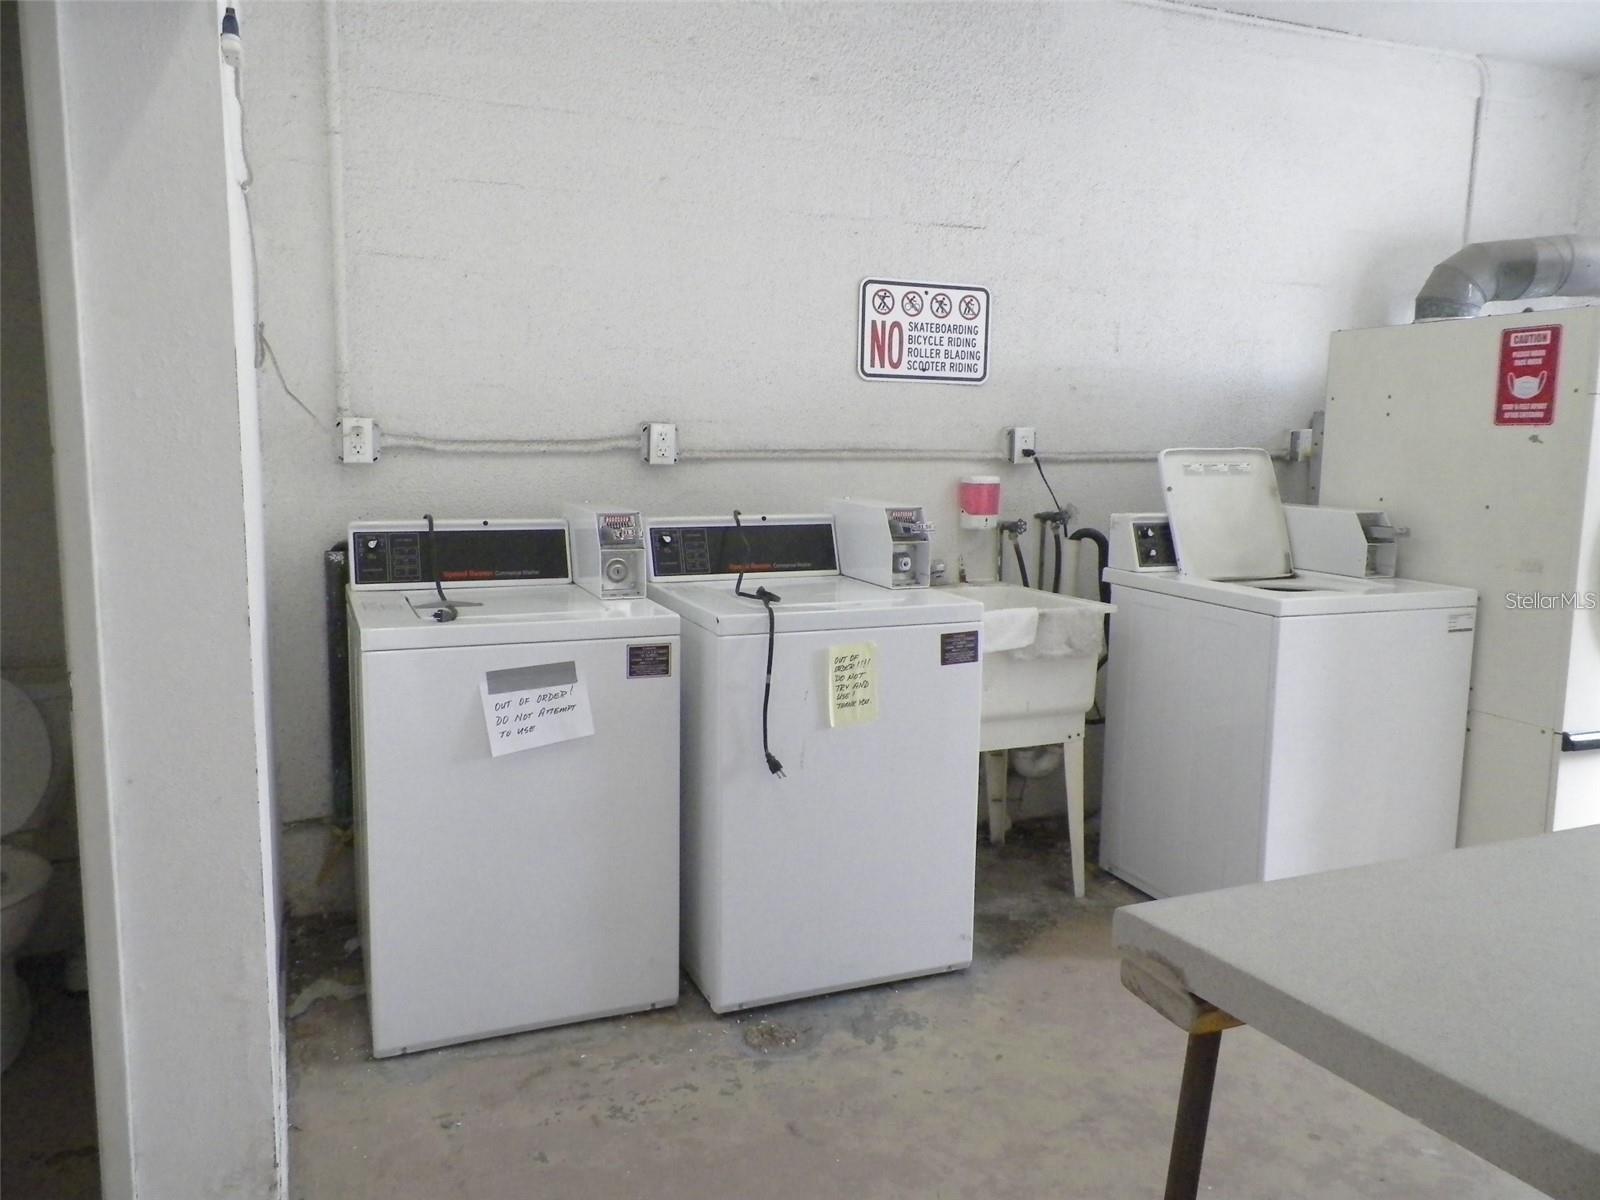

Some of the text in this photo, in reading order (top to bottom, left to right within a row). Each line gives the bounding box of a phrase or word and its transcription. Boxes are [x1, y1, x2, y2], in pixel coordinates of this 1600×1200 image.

[908, 321, 979, 336] SKATEBOARDING
[870, 319, 904, 369] NO
[907, 335, 977, 348] BICYCLE RIDING
[907, 347, 981, 361] ROLLER BLADING
[906, 360, 978, 373] SCOOTER RIDING
[834, 654, 860, 665] OUT OF
[834, 671, 867, 682] DO NOT
[835, 679, 870, 693] TRY AND
[494, 700, 512, 712] OUT
[518, 697, 531, 706] OF
[495, 704, 577, 727] DO NOT ATTEMPT
[499, 725, 536, 739] TO USE
